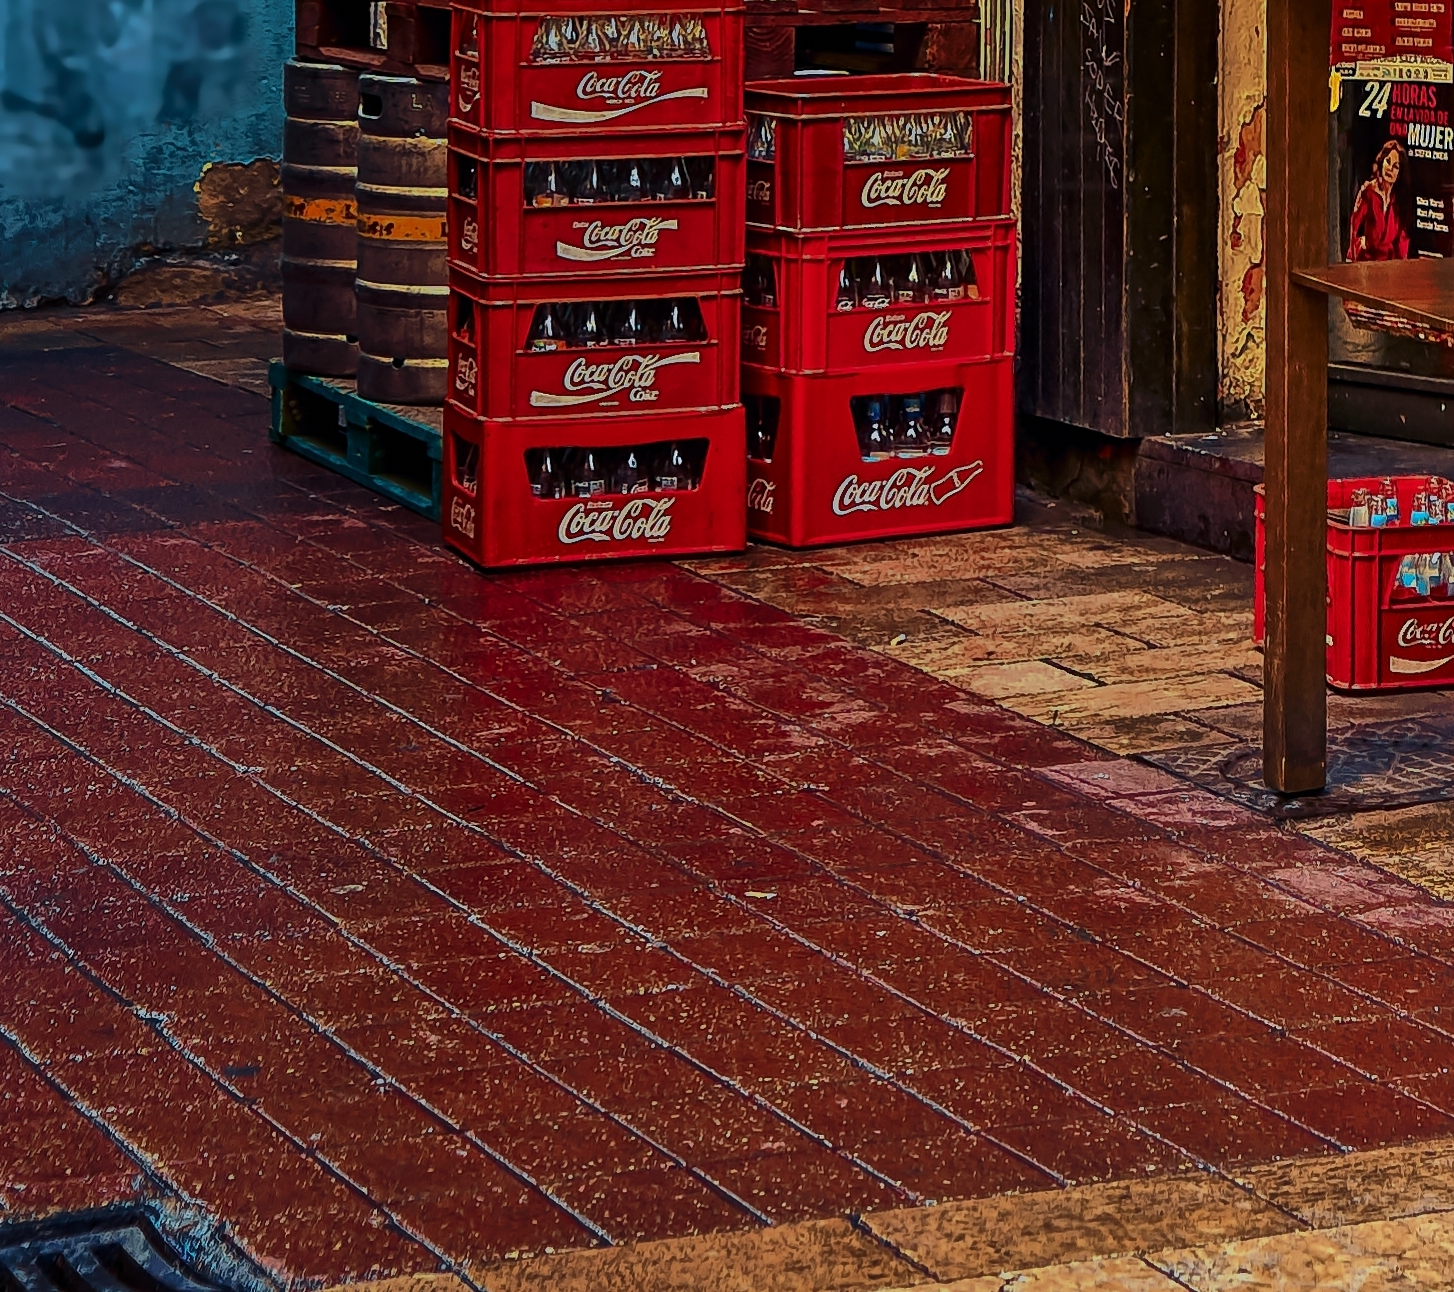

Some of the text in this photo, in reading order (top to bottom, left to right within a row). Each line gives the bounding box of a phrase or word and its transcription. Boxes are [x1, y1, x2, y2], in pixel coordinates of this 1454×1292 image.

[576, 69, 663, 102] Coca-Cola
[1358, 81, 1437, 119] 24 HORAS
[1407, 122, 1454, 151] MUJER
[860, 167, 951, 209] Coca-Cola
[863, 310, 952, 353] Coca-Cola
[563, 354, 656, 391] Coca-Cola
[832, 464, 935, 517] Coca-Cola
[557, 495, 676, 545] Coca-Cola
